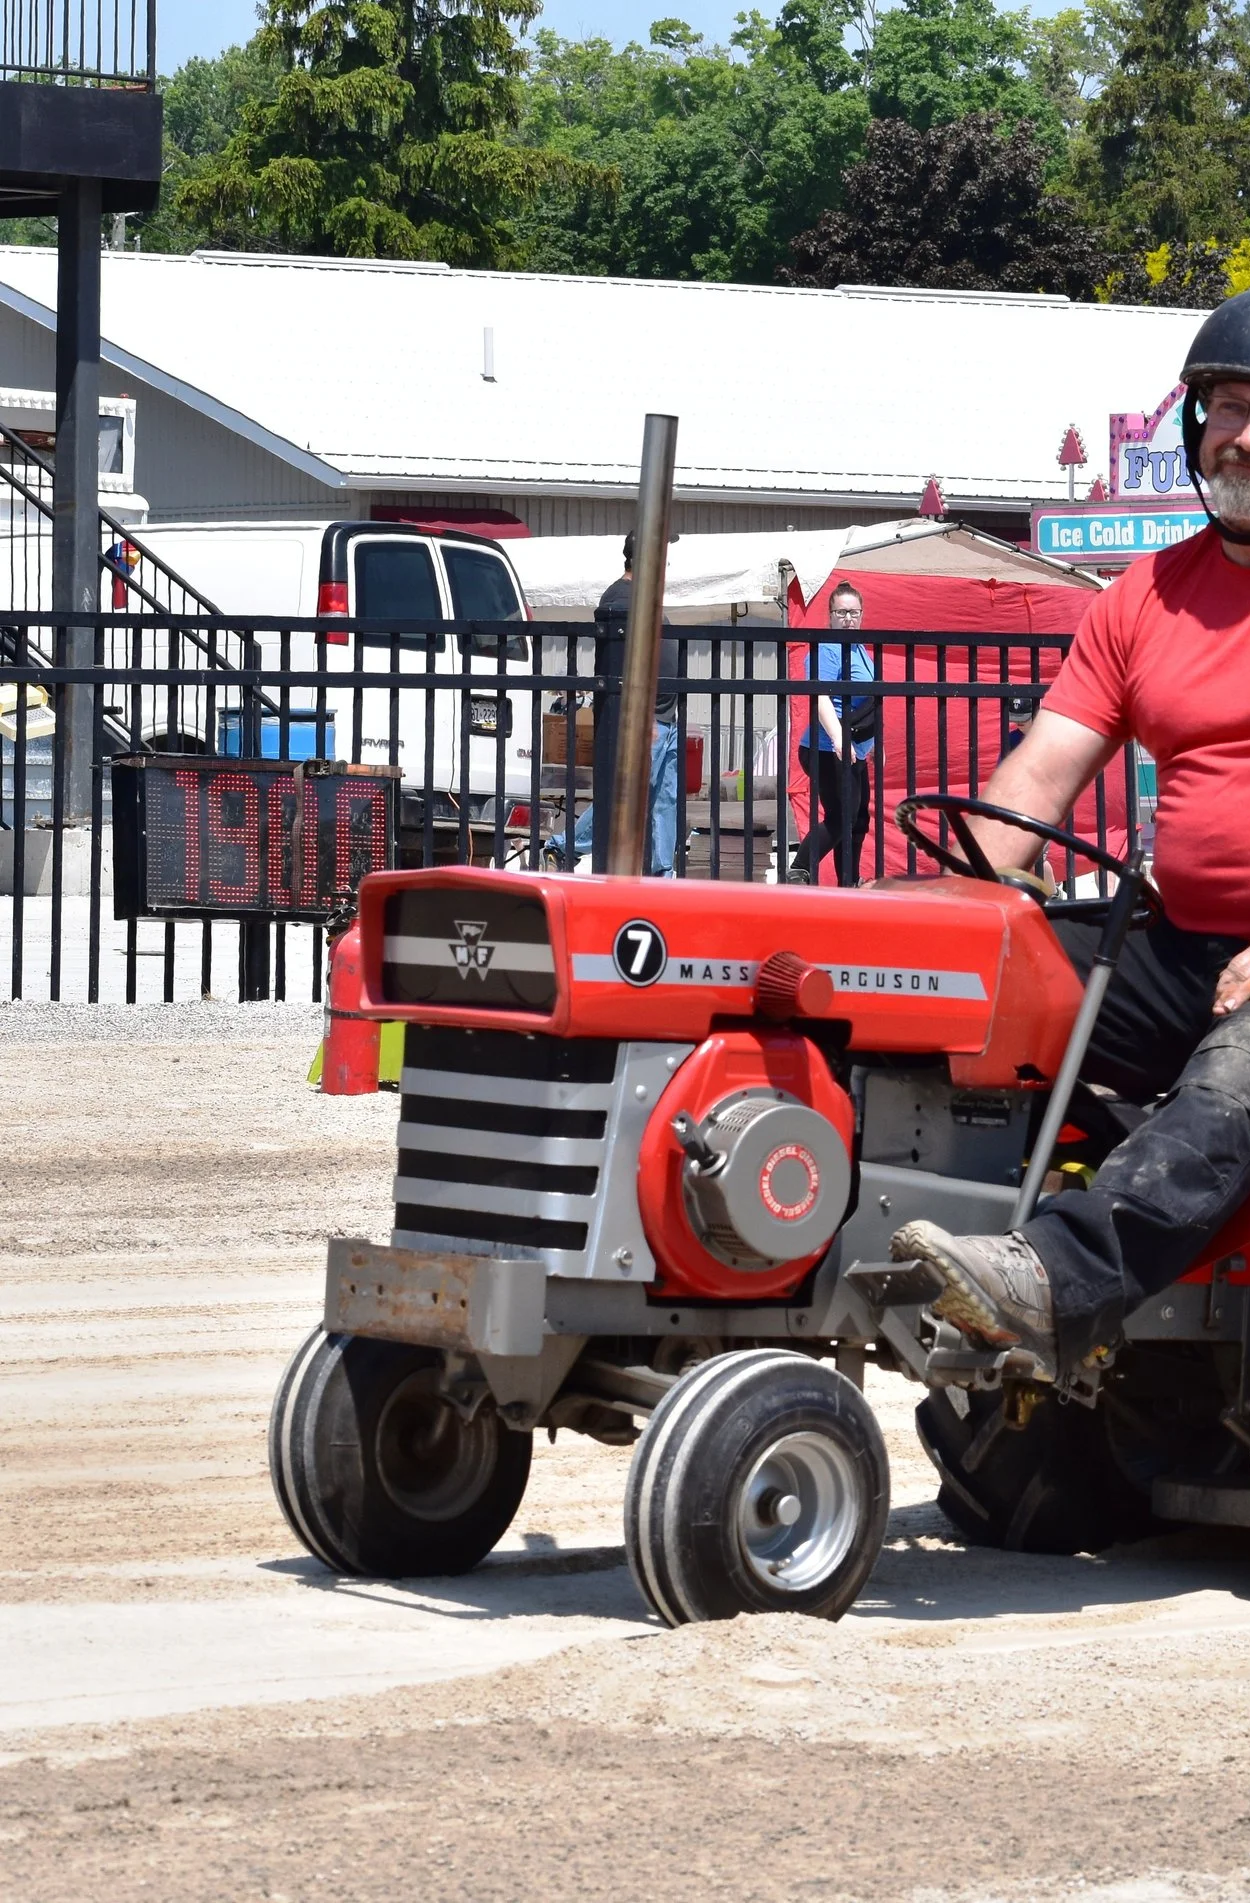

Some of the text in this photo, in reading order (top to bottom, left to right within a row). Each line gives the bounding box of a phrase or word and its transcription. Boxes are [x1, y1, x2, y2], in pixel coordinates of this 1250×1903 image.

[1051, 522, 1084, 548] Ice
[1089, 520, 1135, 547] Cold
[627, 929, 652, 975] 7
[680, 963, 939, 991] MASS RGUSON
[766, 1146, 798, 1172] DIESEL
